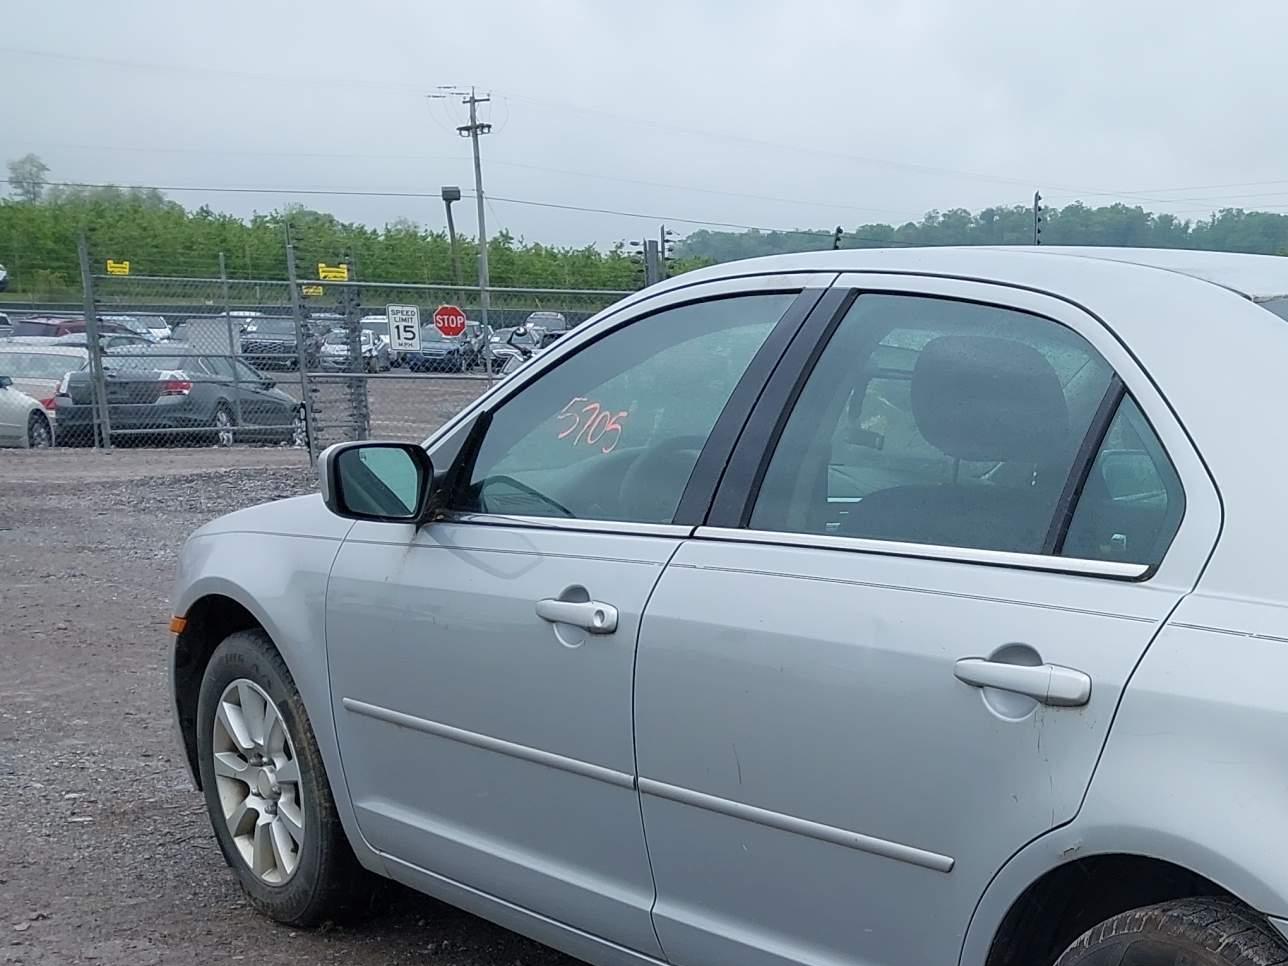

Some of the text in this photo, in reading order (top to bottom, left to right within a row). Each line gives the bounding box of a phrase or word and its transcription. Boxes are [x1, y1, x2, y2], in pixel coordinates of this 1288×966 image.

[390, 309, 416, 317] SPEED
[436, 315, 464, 328] STOP
[394, 324, 417, 341] 15
[557, 397, 628, 454] 5705
